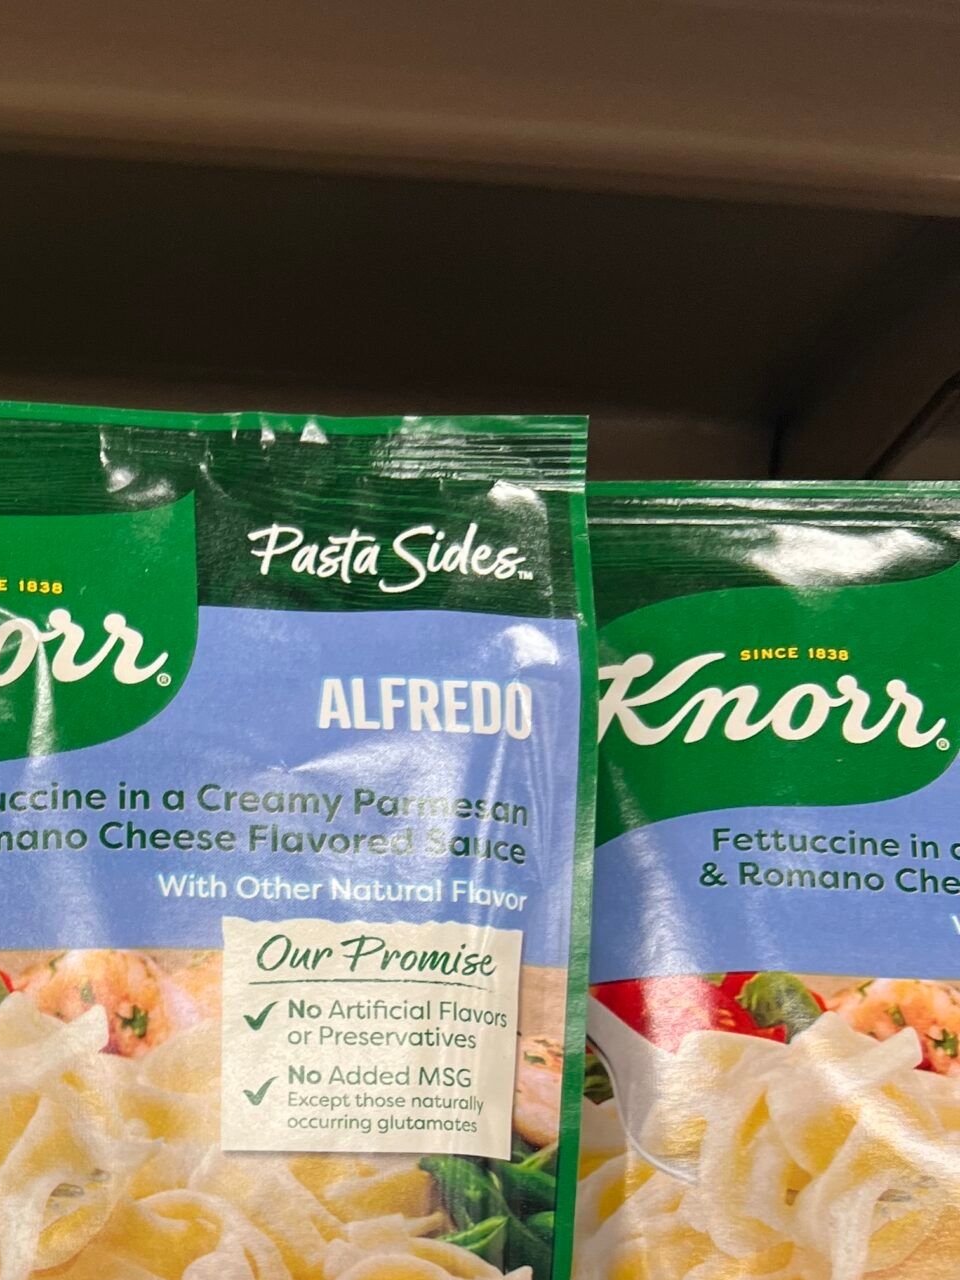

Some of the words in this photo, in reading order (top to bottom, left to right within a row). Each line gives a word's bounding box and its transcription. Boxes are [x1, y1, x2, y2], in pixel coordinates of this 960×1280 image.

[247, 523, 380, 584] Pasta
[379, 522, 526, 593] Sides
[18, 579, 64, 594] 1838
[740, 647, 799, 662] SINCE
[808, 647, 850, 662] 1838
[318, 676, 533, 740] ALFREDO
[598, 652, 946, 748] Knorr
[118, 781, 150, 811] in
[161, 789, 185, 811] a
[197, 783, 343, 823] Creamy
[353, 787, 529, 827] Parmesan
[98, 821, 237, 852] Cheese
[248, 823, 414, 856] Flavored
[424, 827, 527, 865] Sauce
[711, 827, 900, 857] Fettuccine
[910, 833, 940, 860] in
[698, 861, 728, 887] &
[738, 861, 886, 891] Romano
[157, 873, 227, 899] With
[236, 875, 323, 901] Other
[330, 877, 442, 902] Natural
[452, 880, 528, 912] Flavor
[256, 934, 333, 971] Our
[340, 934, 497, 977] Promise
[288, 999, 322, 1019] No
[328, 999, 431, 1020] Artificial
[439, 1000, 508, 1028] Flavors
[287, 1029, 311, 1046] or
[319, 1025, 478, 1050] Preservatives
[288, 1064, 322, 1085] No
[328, 1064, 411, 1086] Added
[418, 1066, 472, 1088] MSG
[287, 1091, 352, 1111] Except
[355, 1092, 406, 1108] those
[410, 1095, 485, 1115] naturally
[287, 1114, 373, 1134] occurring
[377, 1115, 478, 1133] glutamates
